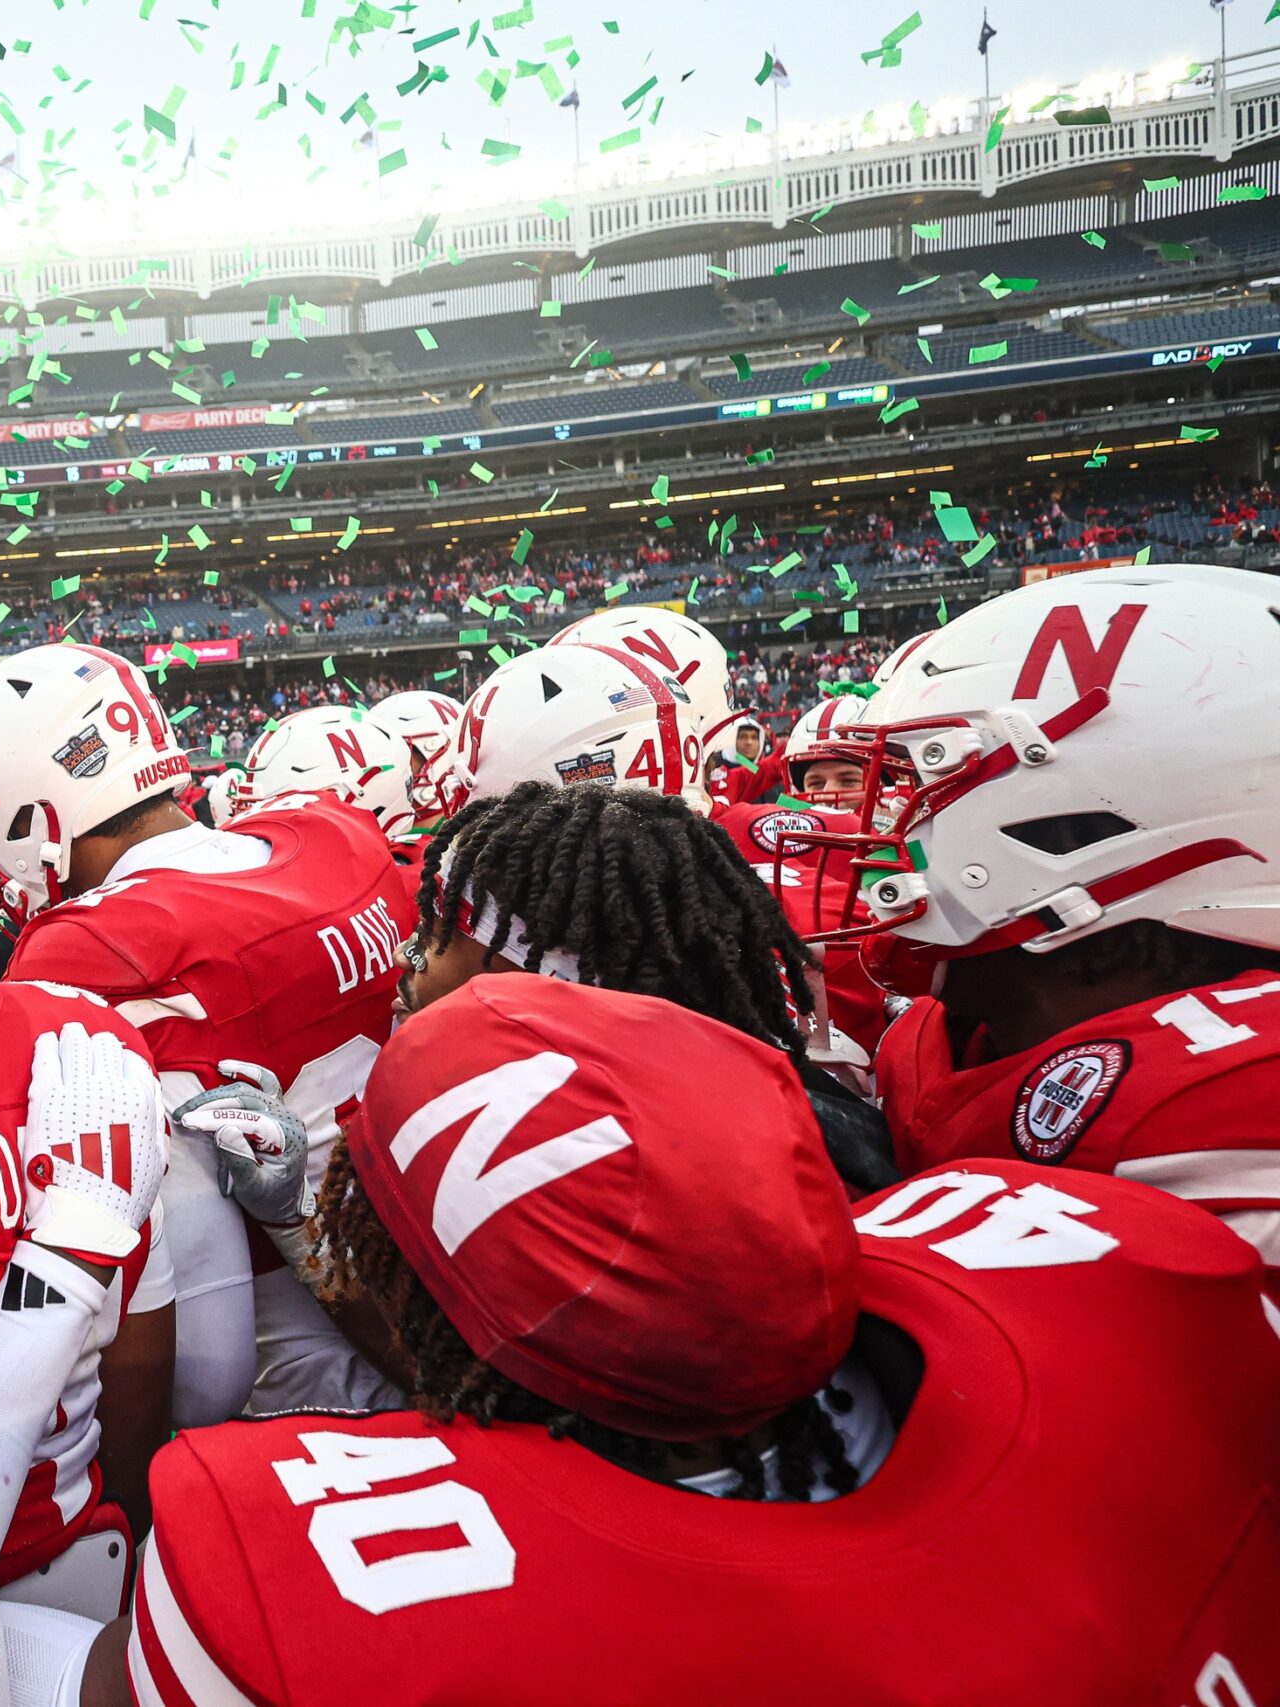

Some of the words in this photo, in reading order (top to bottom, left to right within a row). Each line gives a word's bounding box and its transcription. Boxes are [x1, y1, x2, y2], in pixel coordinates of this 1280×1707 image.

[1152, 349, 1192, 366] BAD
[53, 421, 87, 436] DECK
[195, 411, 230, 426] PARTY
[331, 447, 341, 462] 4
[348, 445, 367, 461] 25
[621, 628, 680, 673] N
[1012, 604, 1148, 700] N
[429, 698, 459, 725] N
[327, 729, 367, 773] N
[625, 734, 701, 787] 49
[563, 768, 585, 778] BAD
[588, 761, 610, 771] BOY
[1038, 1079, 1084, 1111] HUSKERS
[213, 1110, 261, 1123] ADIZERO
[389, 1051, 633, 1256] N
[853, 1171, 1120, 1270] 40
[271, 1430, 516, 1616] 40
